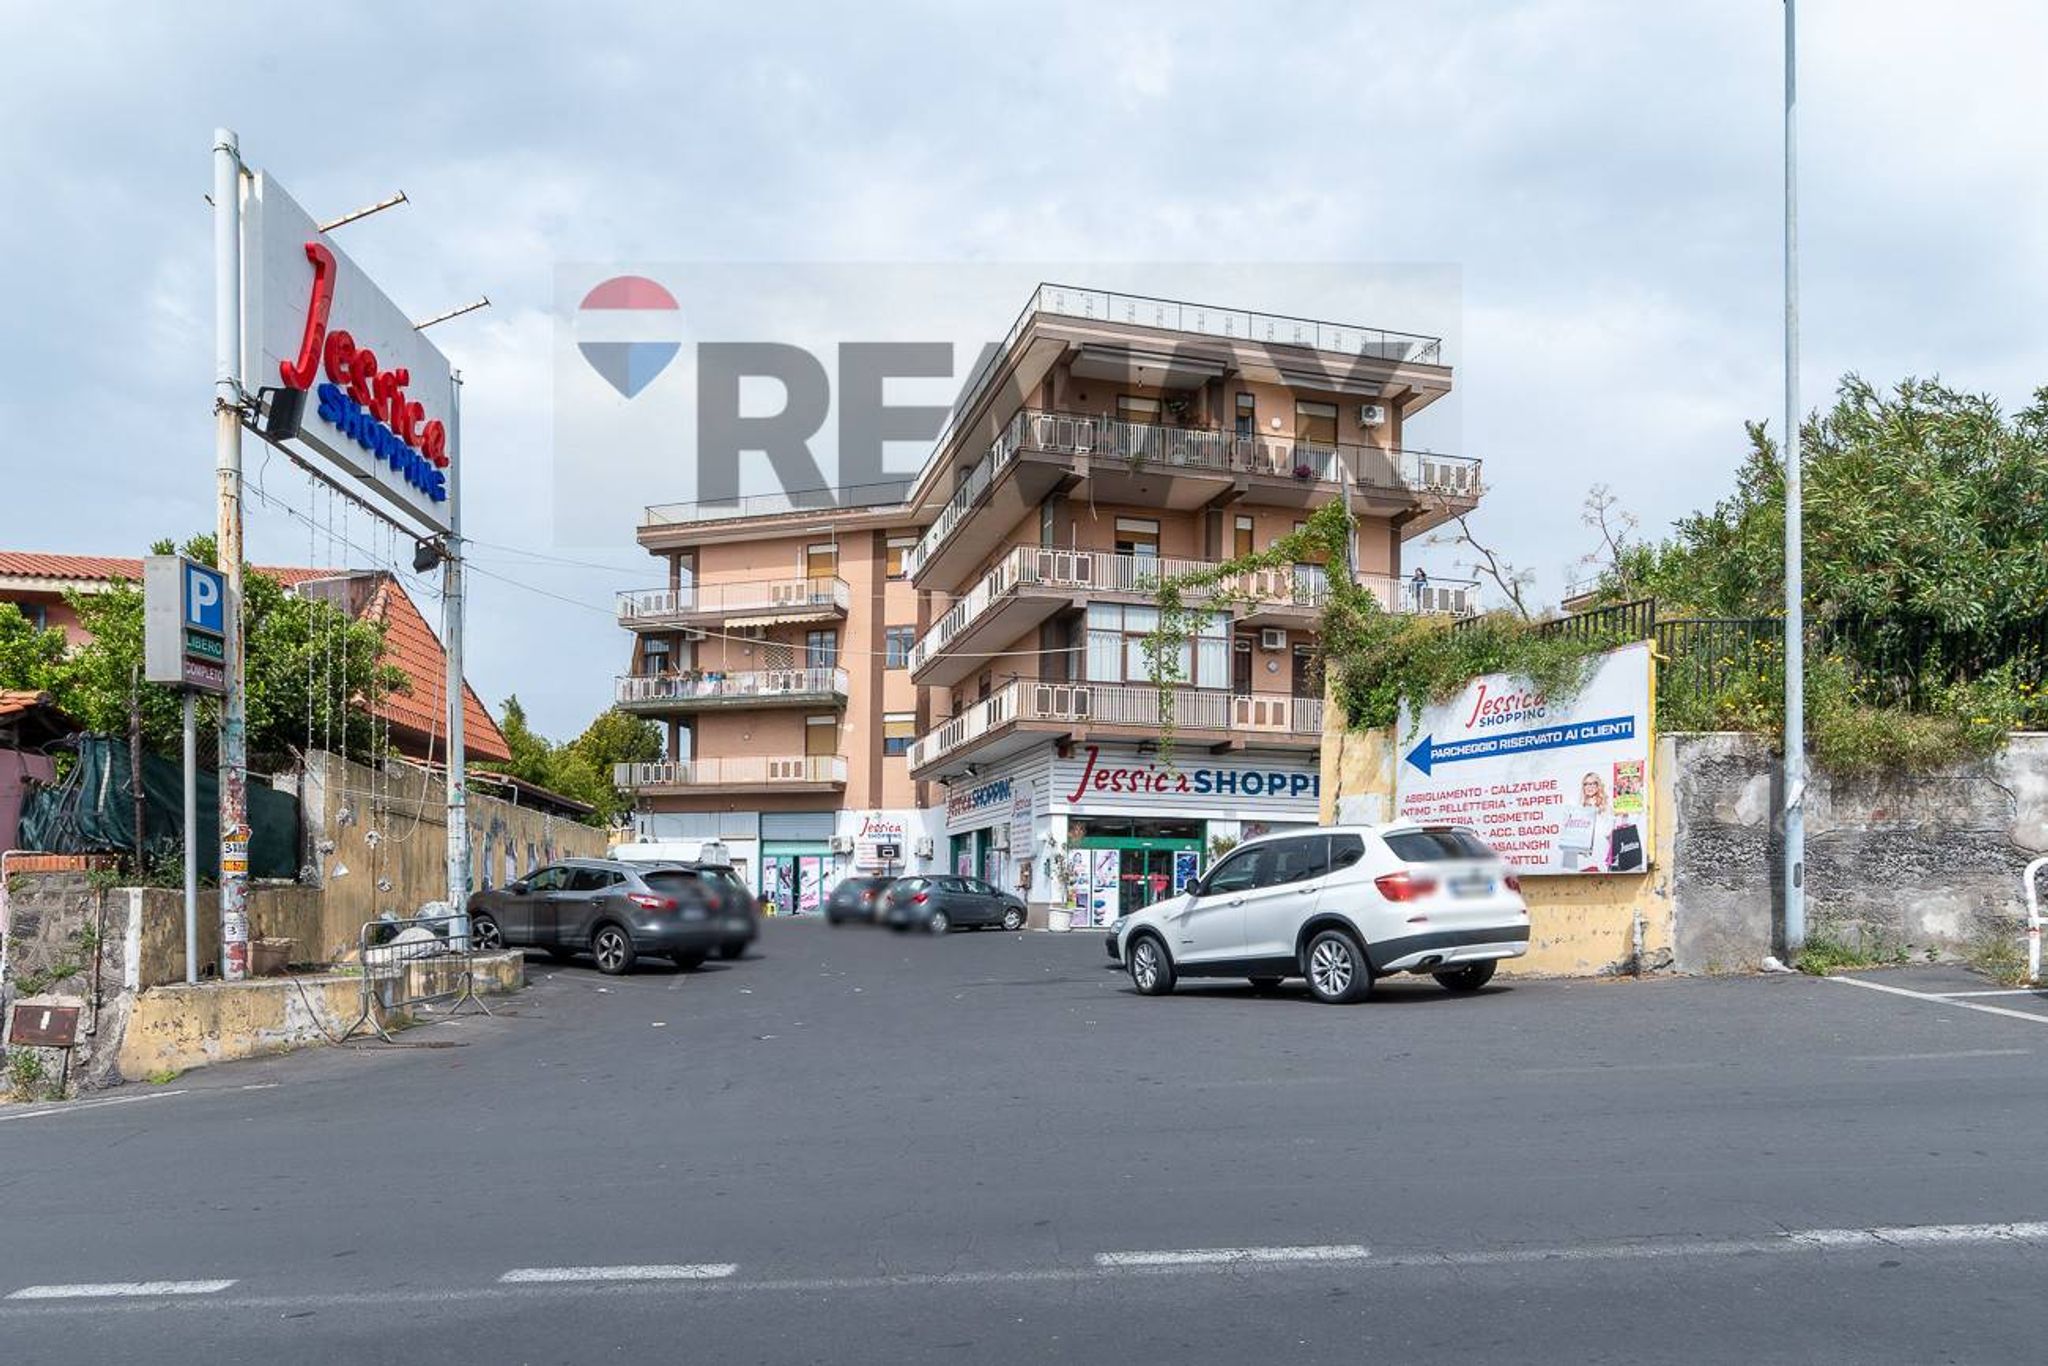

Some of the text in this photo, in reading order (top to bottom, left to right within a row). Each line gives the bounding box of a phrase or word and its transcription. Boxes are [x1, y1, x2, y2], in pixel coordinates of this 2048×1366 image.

[280, 241, 449, 468] Jessica
[190, 569, 219, 624] P
[186, 635, 222, 655] LIBERO
[1465, 685, 1547, 729] Jessica
[1479, 707, 1546, 728] SHOPPING
[1431, 722, 1632, 760] PARCHEGGIO RISERVATO AI CLIENTI
[1067, 745, 1190, 803] Jessica
[1405, 787, 1482, 803] ABBIGLIAMENTO
[1491, 780, 1558, 795] CALZATURE
[1401, 807, 1431, 817] INTIMO
[1439, 800, 1505, 813] PELLETTERIA
[1517, 795, 1562, 807] TAPPETI
[859, 817, 902, 837] Jessica
[1483, 811, 1544, 824] COSMETICI
[1489, 828, 1515, 837] ACC.
[1519, 824, 1559, 836] BAGNO
[1488, 841, 1550, 852] ASALINGHI
